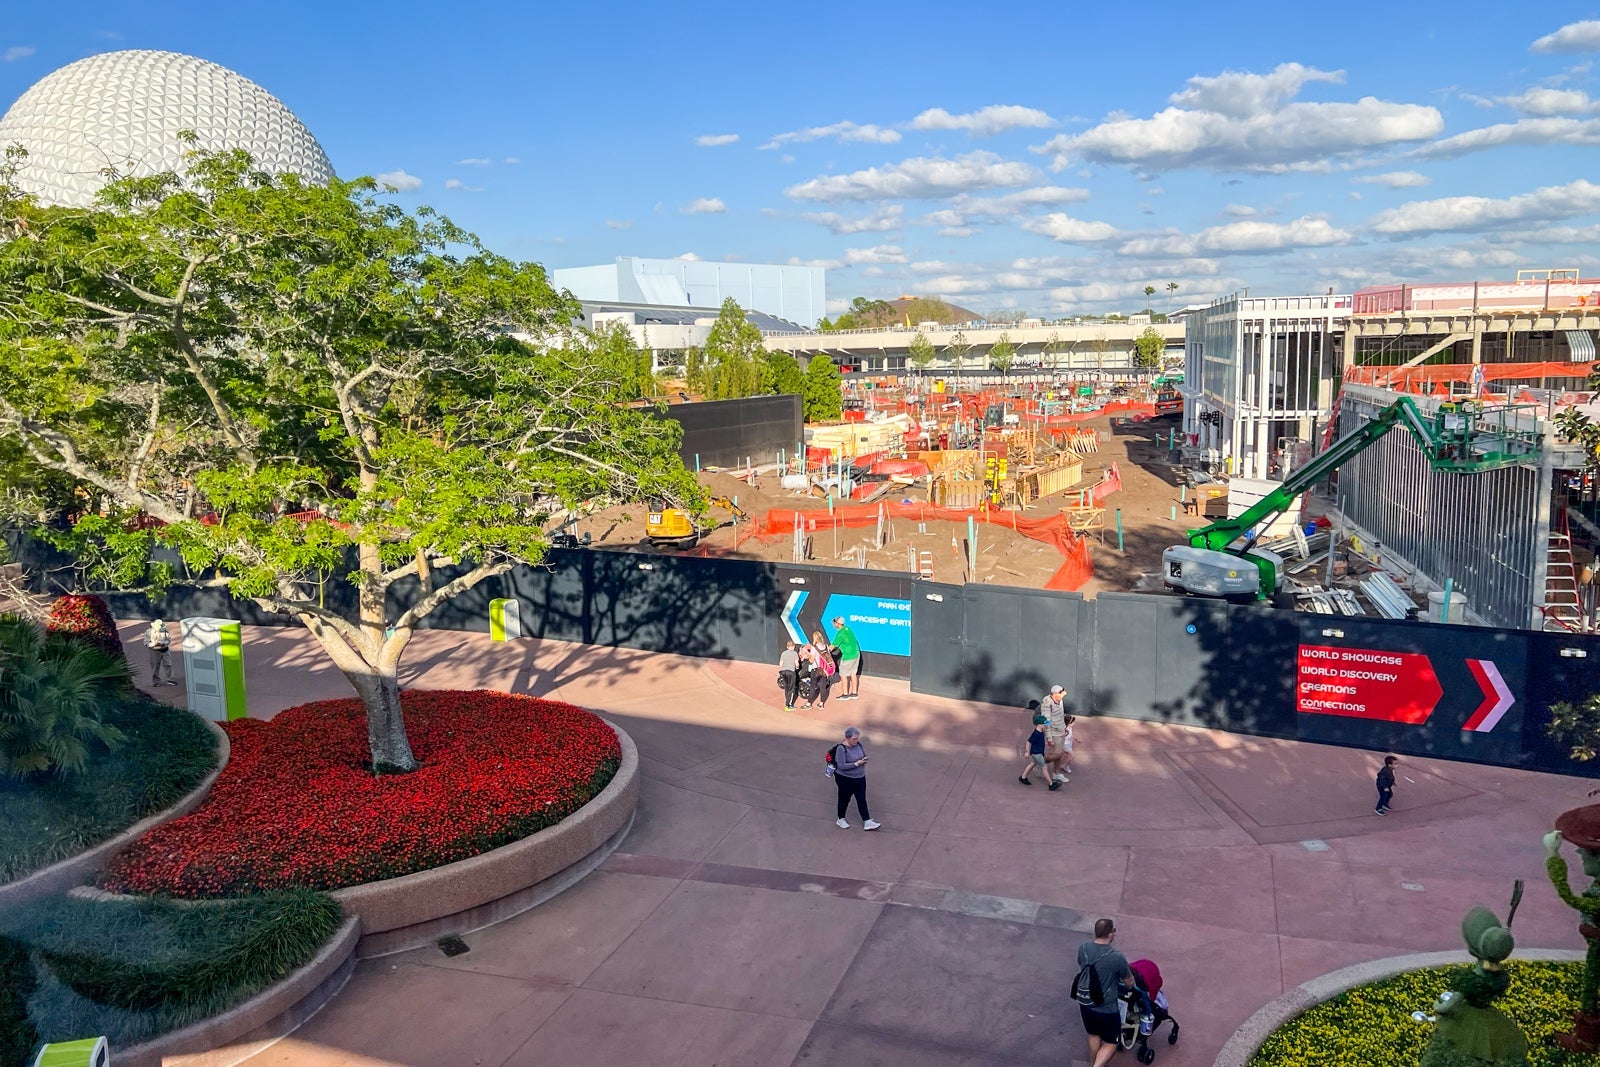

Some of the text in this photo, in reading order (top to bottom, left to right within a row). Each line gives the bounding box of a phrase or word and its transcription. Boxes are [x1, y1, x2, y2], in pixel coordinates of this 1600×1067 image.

[650, 514, 662, 524] CAT
[850, 615, 888, 624] SPACESHIP
[1302, 649, 1402, 666] WORLD SHOWCASE
[1301, 666, 1398, 682] WORLD DISCOVERY
[1300, 682, 1356, 694] CREATIONS
[1300, 698, 1366, 712] CONNECTIONS
